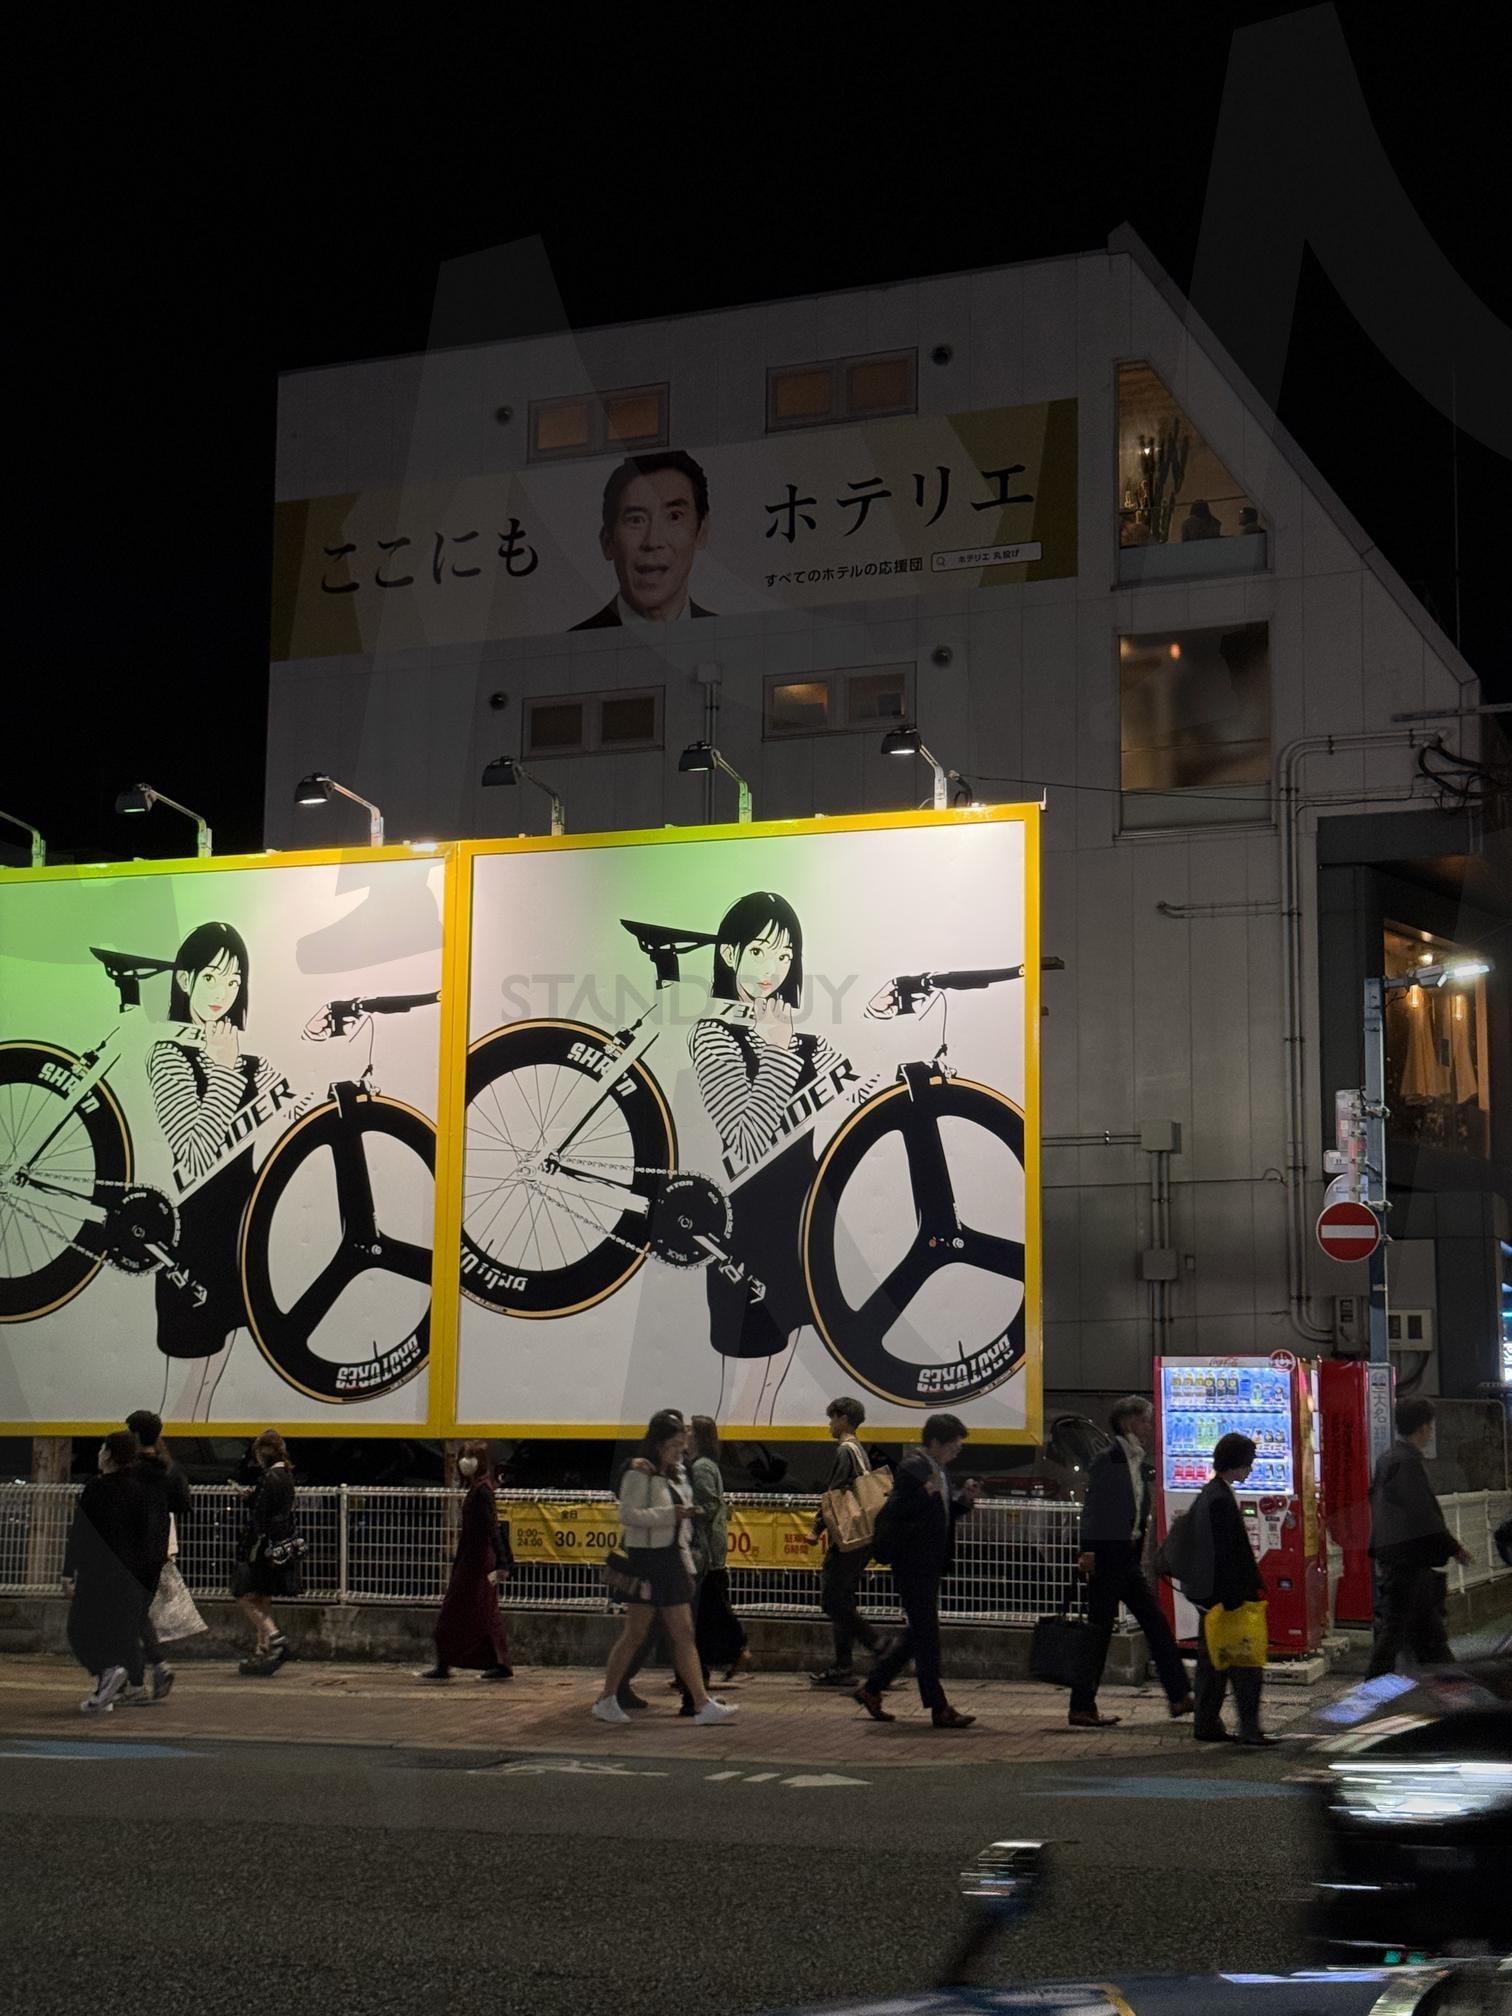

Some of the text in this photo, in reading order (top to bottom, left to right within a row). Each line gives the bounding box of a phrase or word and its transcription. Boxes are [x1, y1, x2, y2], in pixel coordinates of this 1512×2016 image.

[763, 463, 1035, 543] ホテリエ
[321, 518, 538, 594] ここにも
[765, 557, 923, 587] すべてのホテルの応援団
